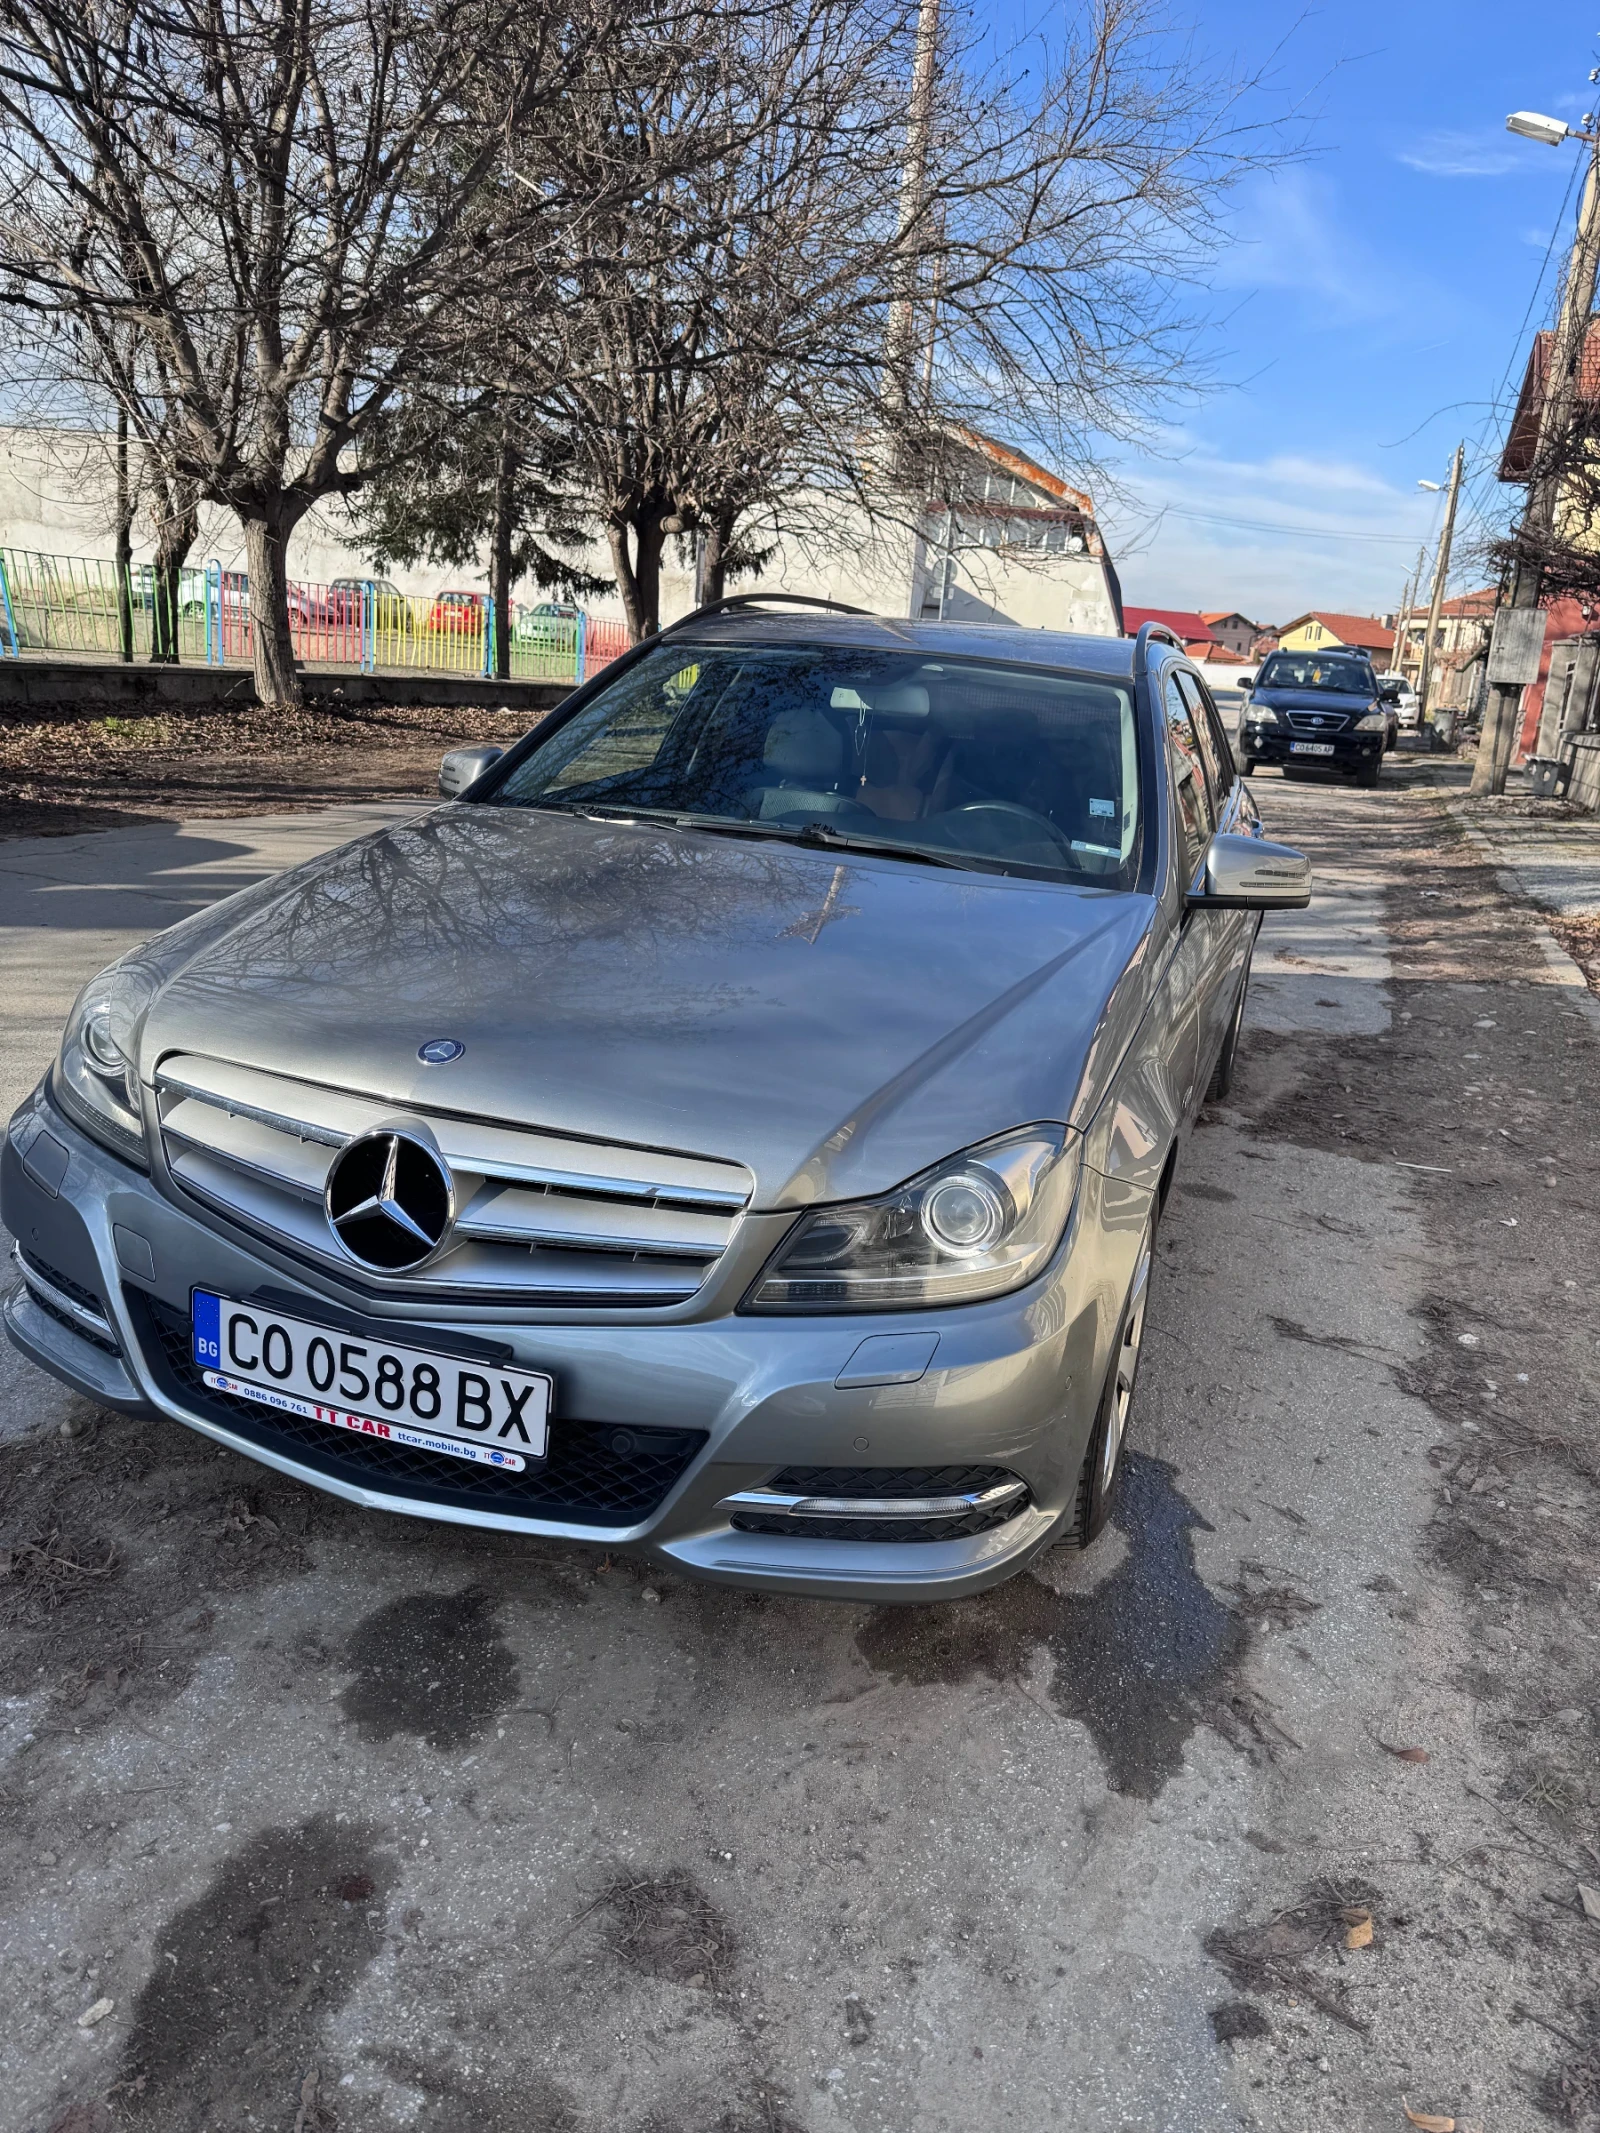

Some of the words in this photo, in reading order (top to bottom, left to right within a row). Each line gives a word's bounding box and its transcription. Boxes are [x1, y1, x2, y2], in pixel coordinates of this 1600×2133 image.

[198, 1336, 218, 1357] BG
[228, 1312, 294, 1380] CO
[306, 1336, 442, 1420] 0588
[456, 1370, 535, 1444] BX
[244, 1387, 267, 1401] 0886
[269, 1395, 288, 1408] 096
[290, 1402, 308, 1414] 761
[312, 1405, 342, 1426] TT
[345, 1415, 392, 1438] CAR
[397, 1431, 477, 1459] ttcar.mobile.bg
